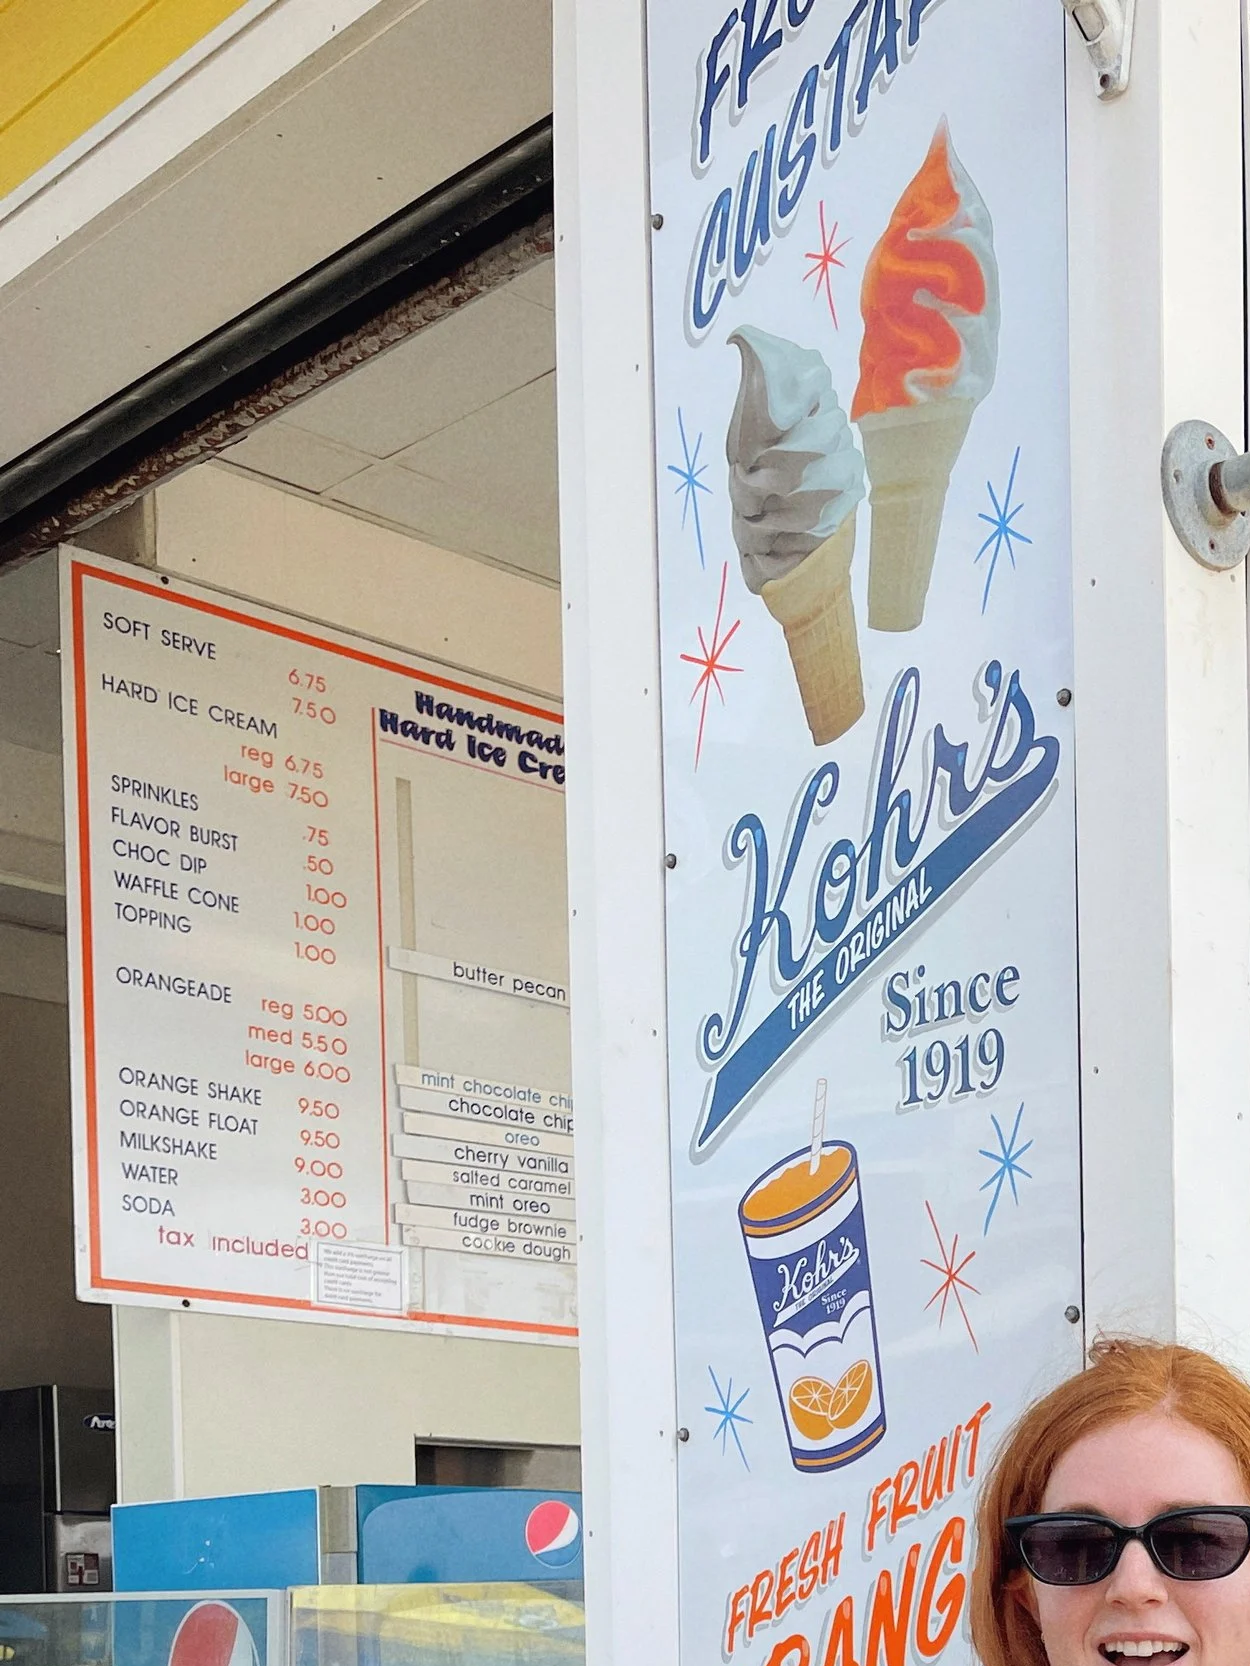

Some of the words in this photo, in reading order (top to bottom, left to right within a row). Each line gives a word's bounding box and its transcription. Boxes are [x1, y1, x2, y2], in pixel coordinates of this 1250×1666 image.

[699, 0, 815, 164] FR
[103, 612, 151, 640] SOFT
[161, 629, 216, 660] SERVE
[288, 669, 327, 693] 6.75
[102, 673, 157, 703] HARD
[168, 692, 198, 716] ICE
[208, 705, 278, 739] CREAM
[292, 697, 336, 724] 7.50
[379, 708, 455, 751] Hard
[466, 734, 507, 767] Ice
[240, 745, 273, 768] reg
[285, 755, 324, 779] 6.75
[111, 774, 199, 811] SPRINKLES
[224, 765, 274, 793] large
[111, 806, 180, 839] FLAVOR
[190, 825, 238, 851] BURST
[303, 826, 329, 846] .75
[112, 839, 171, 867] CHOC
[180, 854, 207, 874] DIP
[303, 855, 333, 876] .50
[702, 659, 1060, 1061] Kohr's
[114, 870, 178, 900] WAFFLE
[188, 887, 240, 913] CONE
[306, 884, 347, 908] 1.00
[114, 902, 191, 933] TOPPING
[294, 911, 336, 935] 1.00
[294, 942, 336, 965] 1.00
[786, 980, 826, 1031] THE
[834, 866, 934, 987] ORIGINAL
[116, 966, 232, 1004] ORANGEADE
[453, 961, 505, 987] butter
[513, 978, 566, 1001] pecan
[261, 998, 293, 1020] reg
[303, 1004, 347, 1027] 5.00
[884, 963, 1020, 1036] Since
[248, 1025, 292, 1045] med
[302, 1032, 347, 1056] 5.50
[244, 1049, 295, 1075] large
[304, 1060, 350, 1083] 6.00
[902, 1027, 1006, 1107] 1919
[118, 1067, 199, 1096] ORANGE
[207, 1081, 262, 1106] SHAKE
[421, 1072, 455, 1089] mint
[463, 1079, 542, 1104] chocolate
[549, 1094, 573, 1111] chi
[119, 1099, 199, 1127] ORANGE
[208, 1112, 258, 1136] FLOAT
[298, 1097, 340, 1119] 9.50
[448, 1098, 535, 1124] chocolate
[119, 1131, 218, 1160] MILKSHAKE
[300, 1129, 340, 1149] 9.50
[504, 1132, 540, 1147] oreo
[121, 1162, 178, 1186] WATER
[294, 1156, 343, 1179] 9.00
[454, 1145, 510, 1169] cherry
[517, 1154, 569, 1174] vanilla
[452, 1170, 500, 1187] salted
[508, 1177, 571, 1195] caramel
[122, 1194, 176, 1217] SODA
[300, 1187, 346, 1208] 3.00
[469, 1193, 504, 1210] mint
[512, 1198, 551, 1214] oreo
[300, 1218, 347, 1239] 3.00
[453, 1212, 500, 1232] fudge
[507, 1218, 567, 1238] brownie
[158, 1225, 195, 1247] tax
[212, 1235, 309, 1260] included
[461, 1235, 515, 1253] cookie
[522, 1241, 571, 1262] dough
[773, 1236, 859, 1312] Kohr's
[821, 1288, 848, 1306] Since
[825, 1297, 846, 1315] 1919
[727, 1511, 847, 1653] FRESH
[867, 1401, 992, 1552] FRUIT
